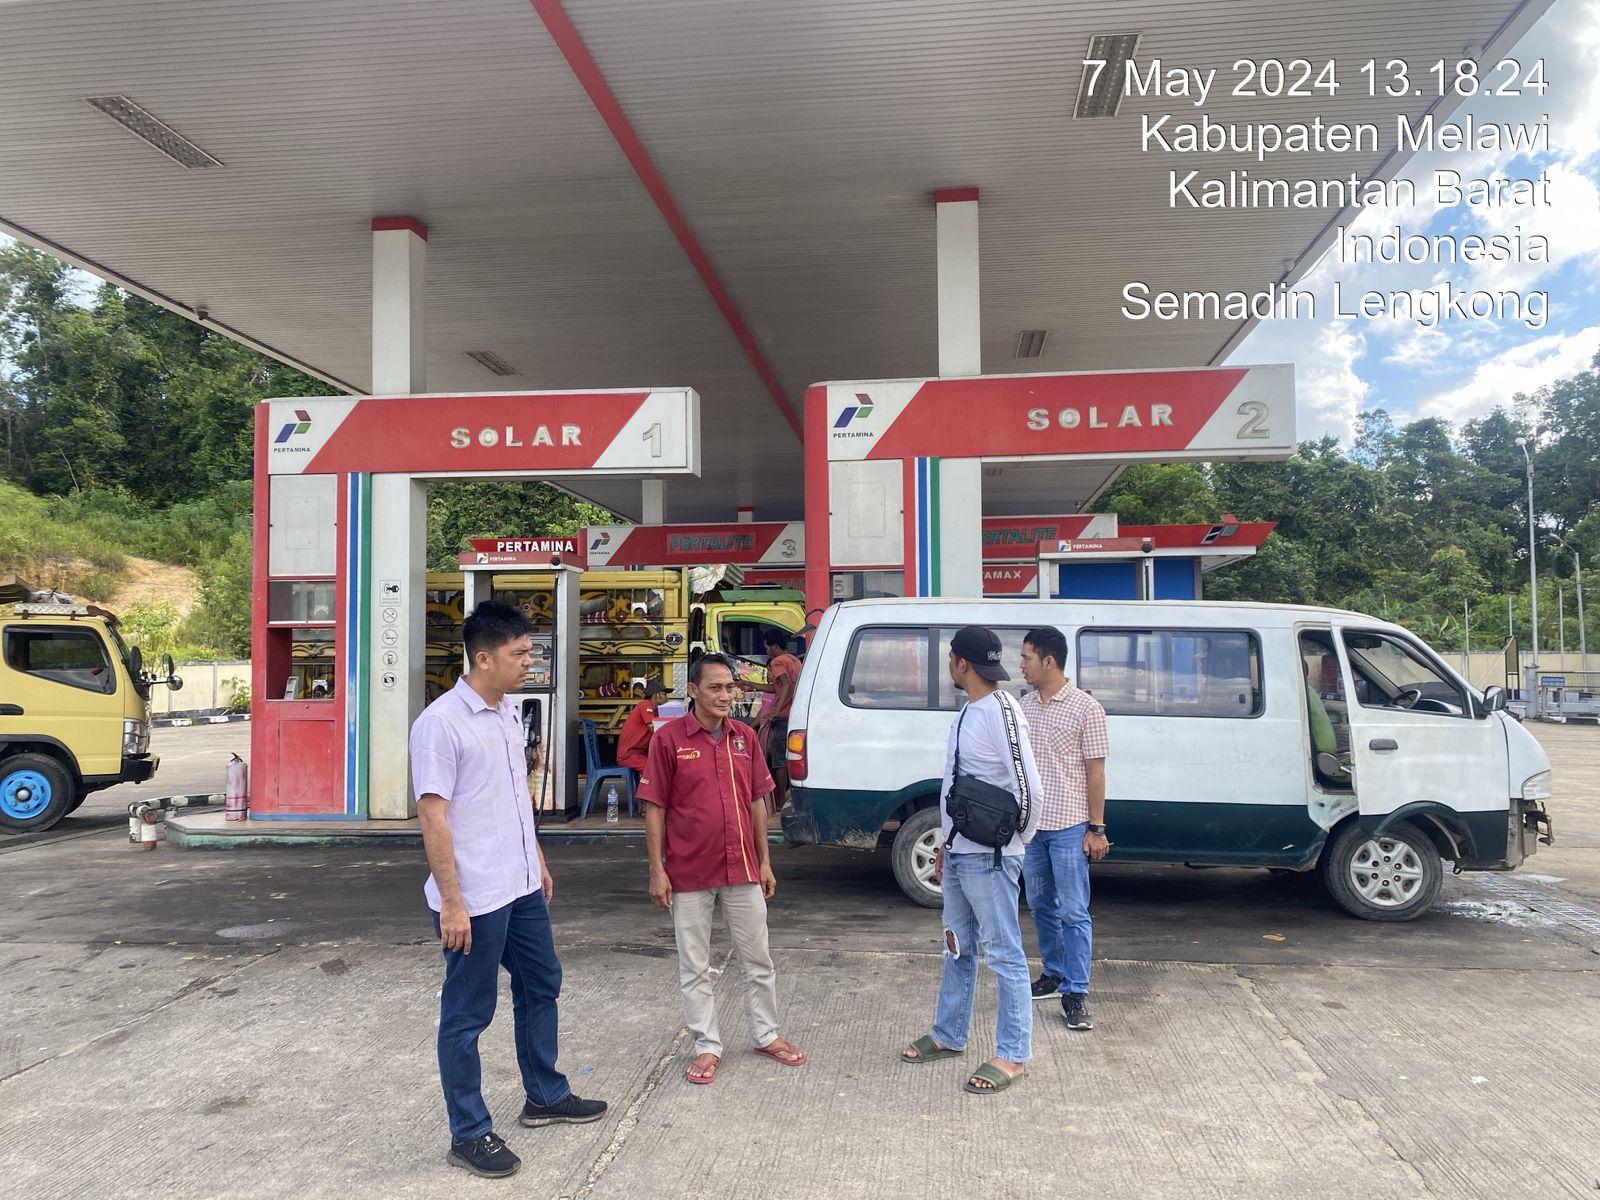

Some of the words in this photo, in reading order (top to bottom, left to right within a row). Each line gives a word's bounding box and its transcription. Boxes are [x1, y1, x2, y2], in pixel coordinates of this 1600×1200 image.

[1026, 402, 1175, 431] SOLAR
[1236, 400, 1271, 440] 2
[449, 423, 583, 449] SOLAR
[642, 422, 662, 458] 1
[832, 431, 875, 439] PERTAMINA
[272, 446, 311, 454] PERTAMINA
[670, 532, 753, 551] PERTALITE
[781, 538, 797, 558] 3
[982, 527, 1057, 545] ERTALITE
[497, 540, 574, 552] PERTAMINA
